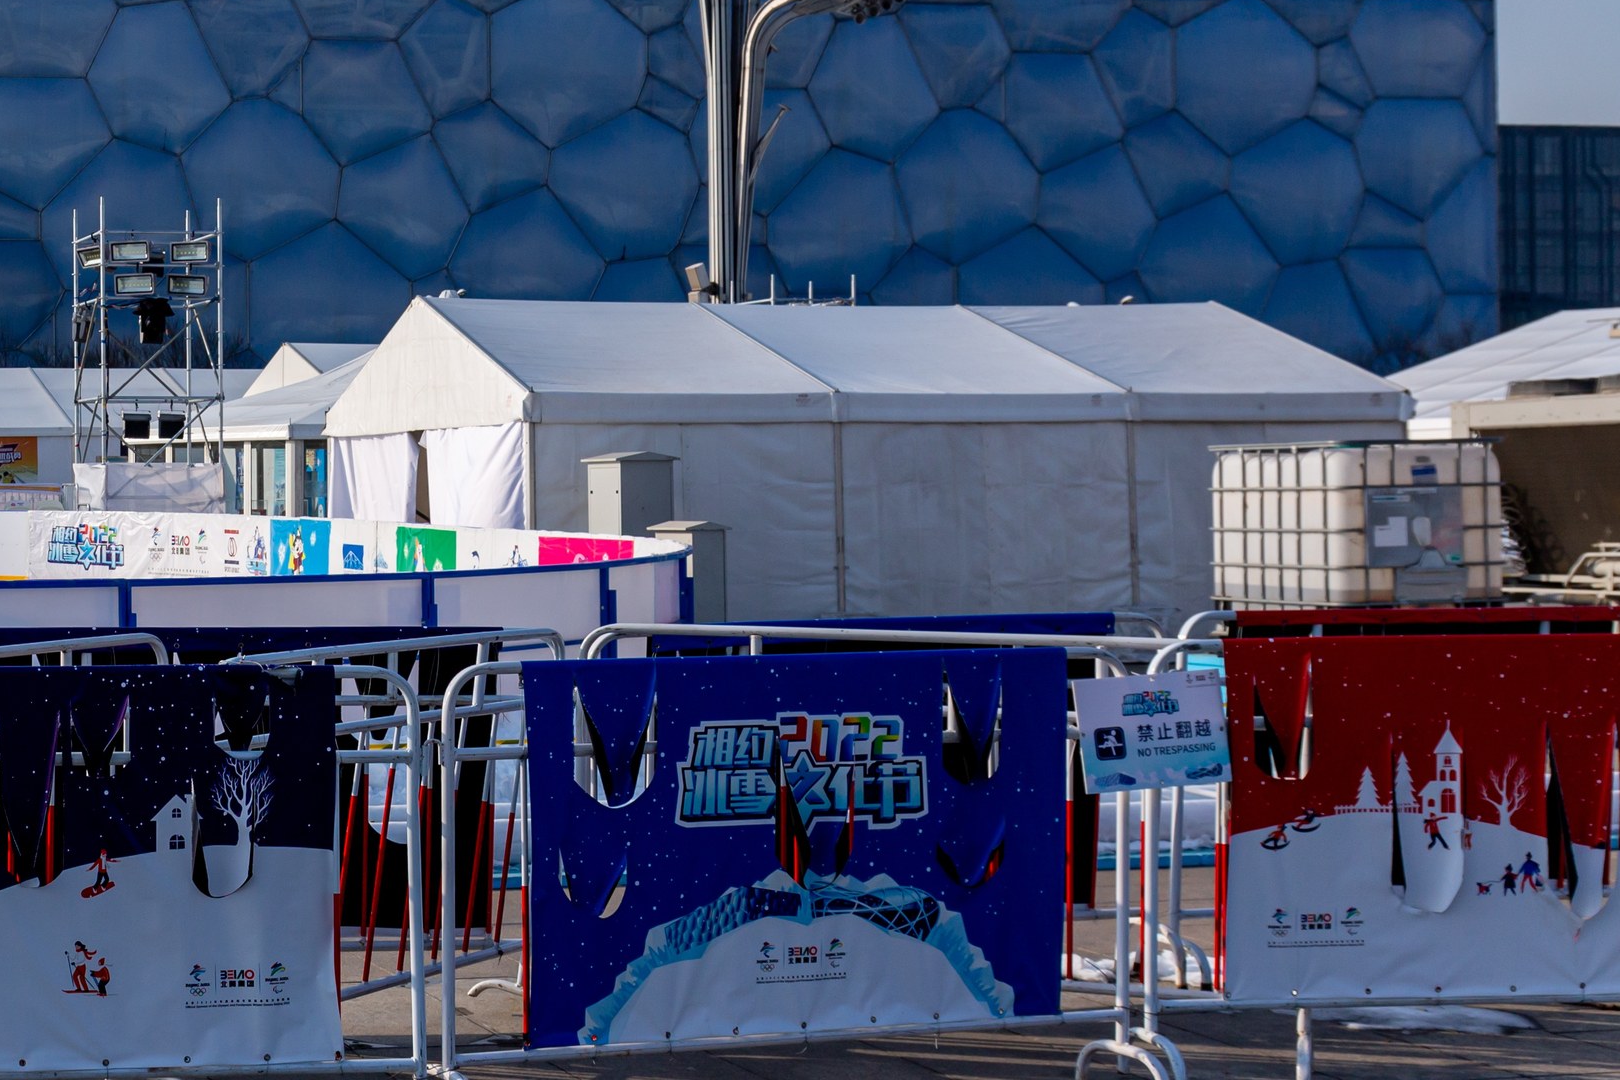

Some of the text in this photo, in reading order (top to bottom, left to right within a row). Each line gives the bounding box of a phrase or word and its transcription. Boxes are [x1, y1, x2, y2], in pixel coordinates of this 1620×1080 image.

[52, 523, 117, 544] 相约2022
[47, 539, 124, 570] 冰雪文化节
[692, 715, 901, 767] 相约2022
[1137, 719, 1212, 742] 禁止翻越
[1137, 742, 1216, 758] NO TRESPASSING
[682, 751, 925, 828] 冰雪文化节
